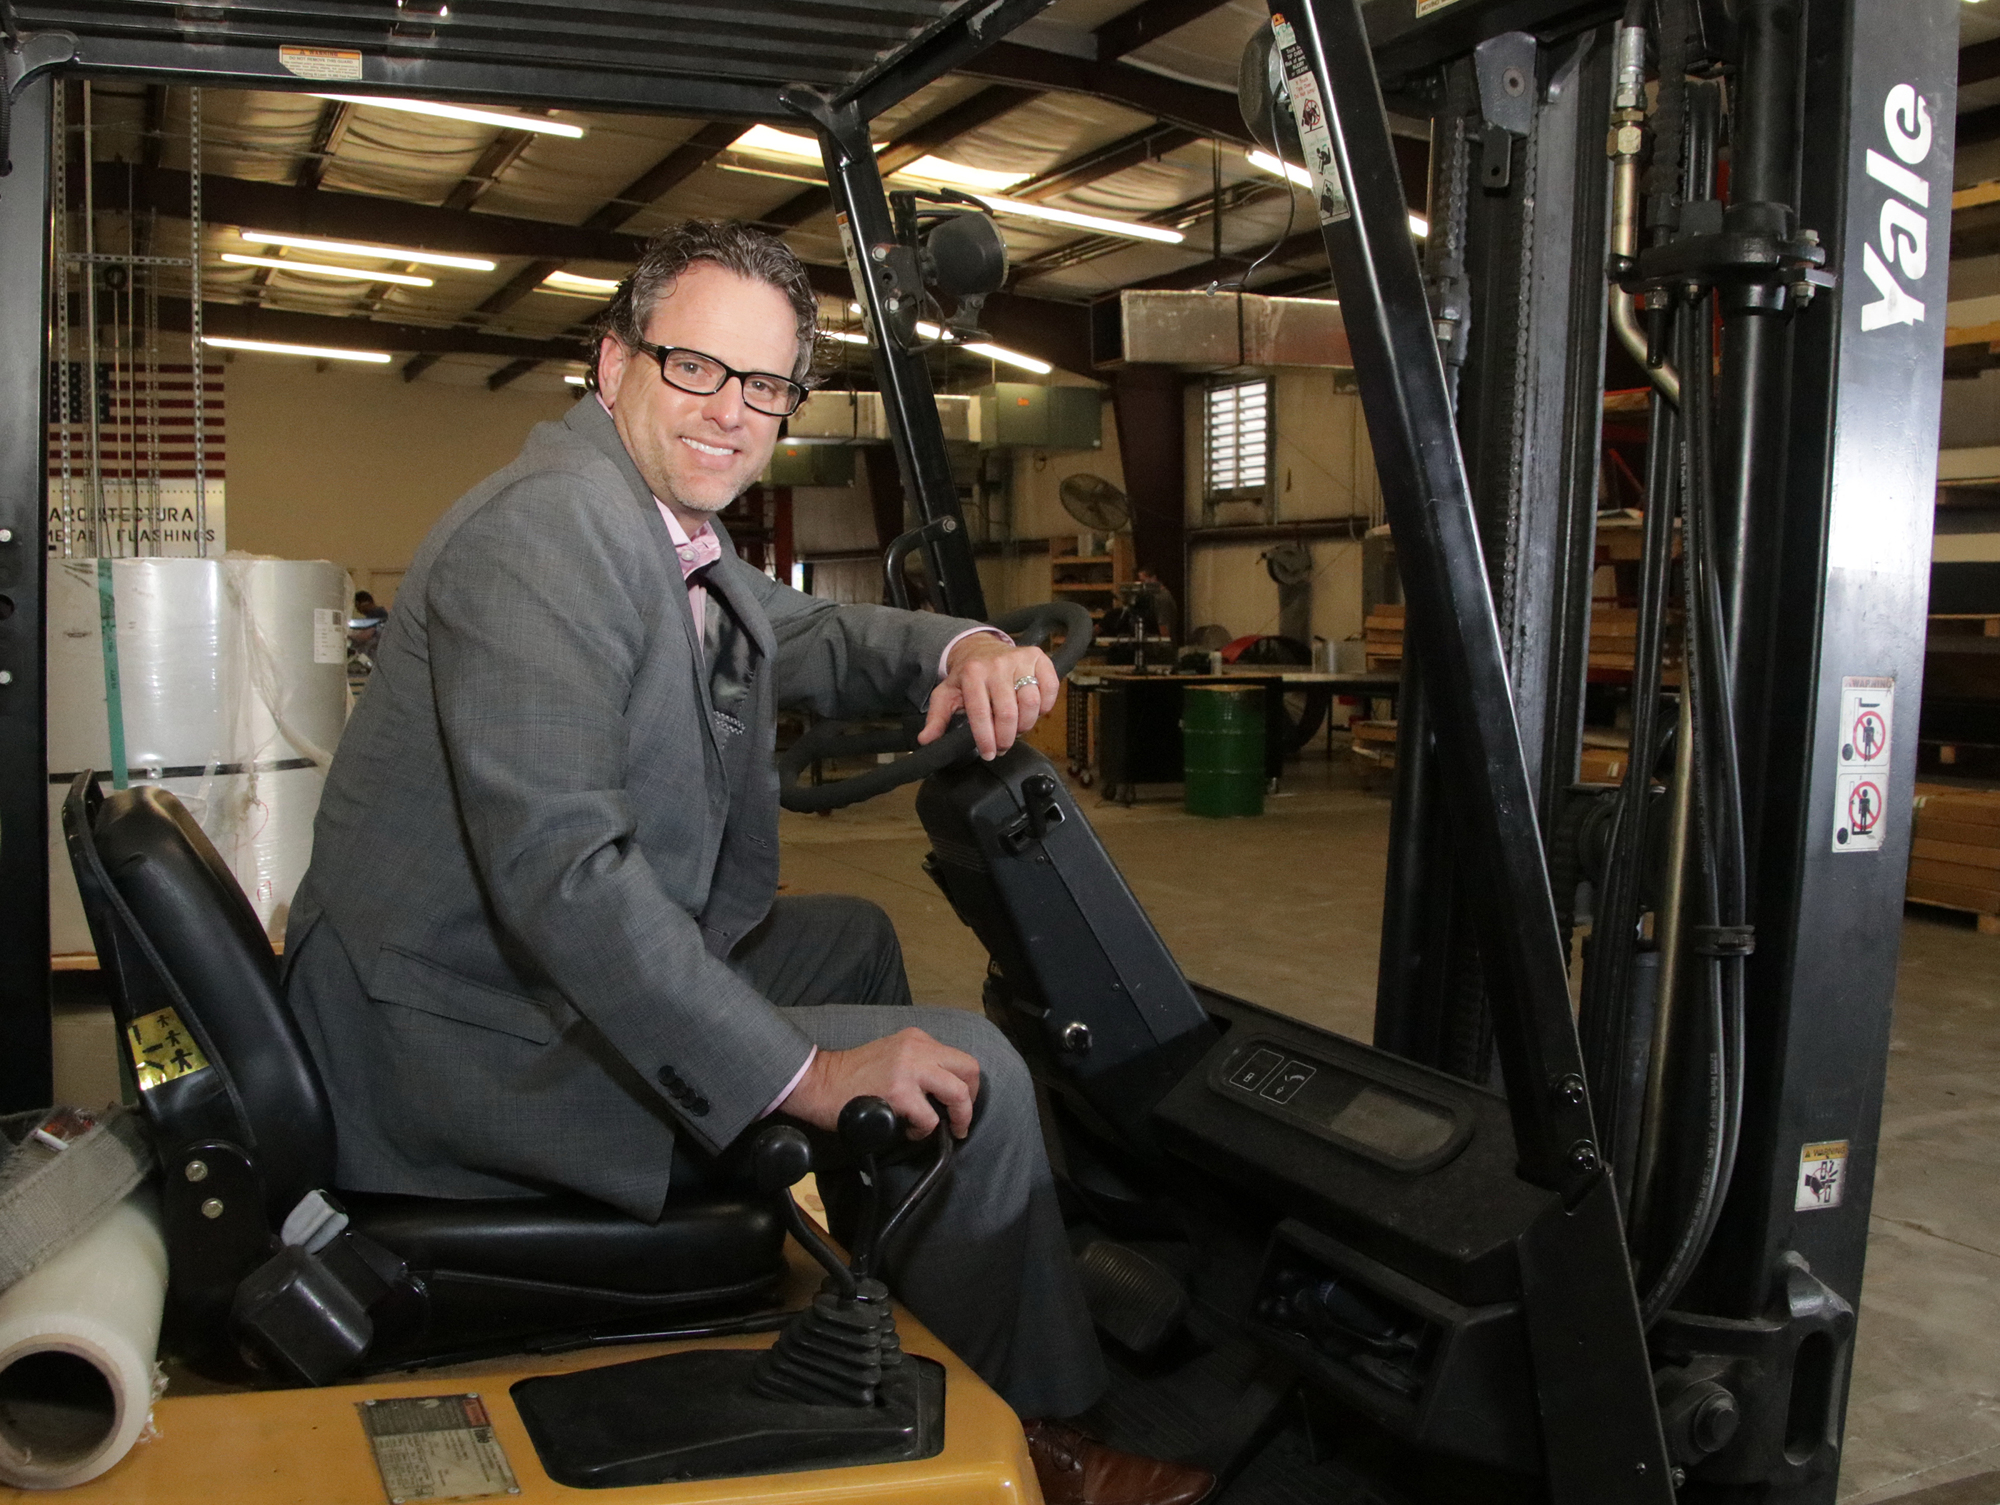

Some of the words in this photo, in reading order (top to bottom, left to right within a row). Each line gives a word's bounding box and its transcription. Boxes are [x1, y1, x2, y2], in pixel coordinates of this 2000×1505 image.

[1861, 83, 1932, 332] Yale
[1851, 679, 1892, 688] WARNING
[1813, 1146, 1846, 1157] WARNING
